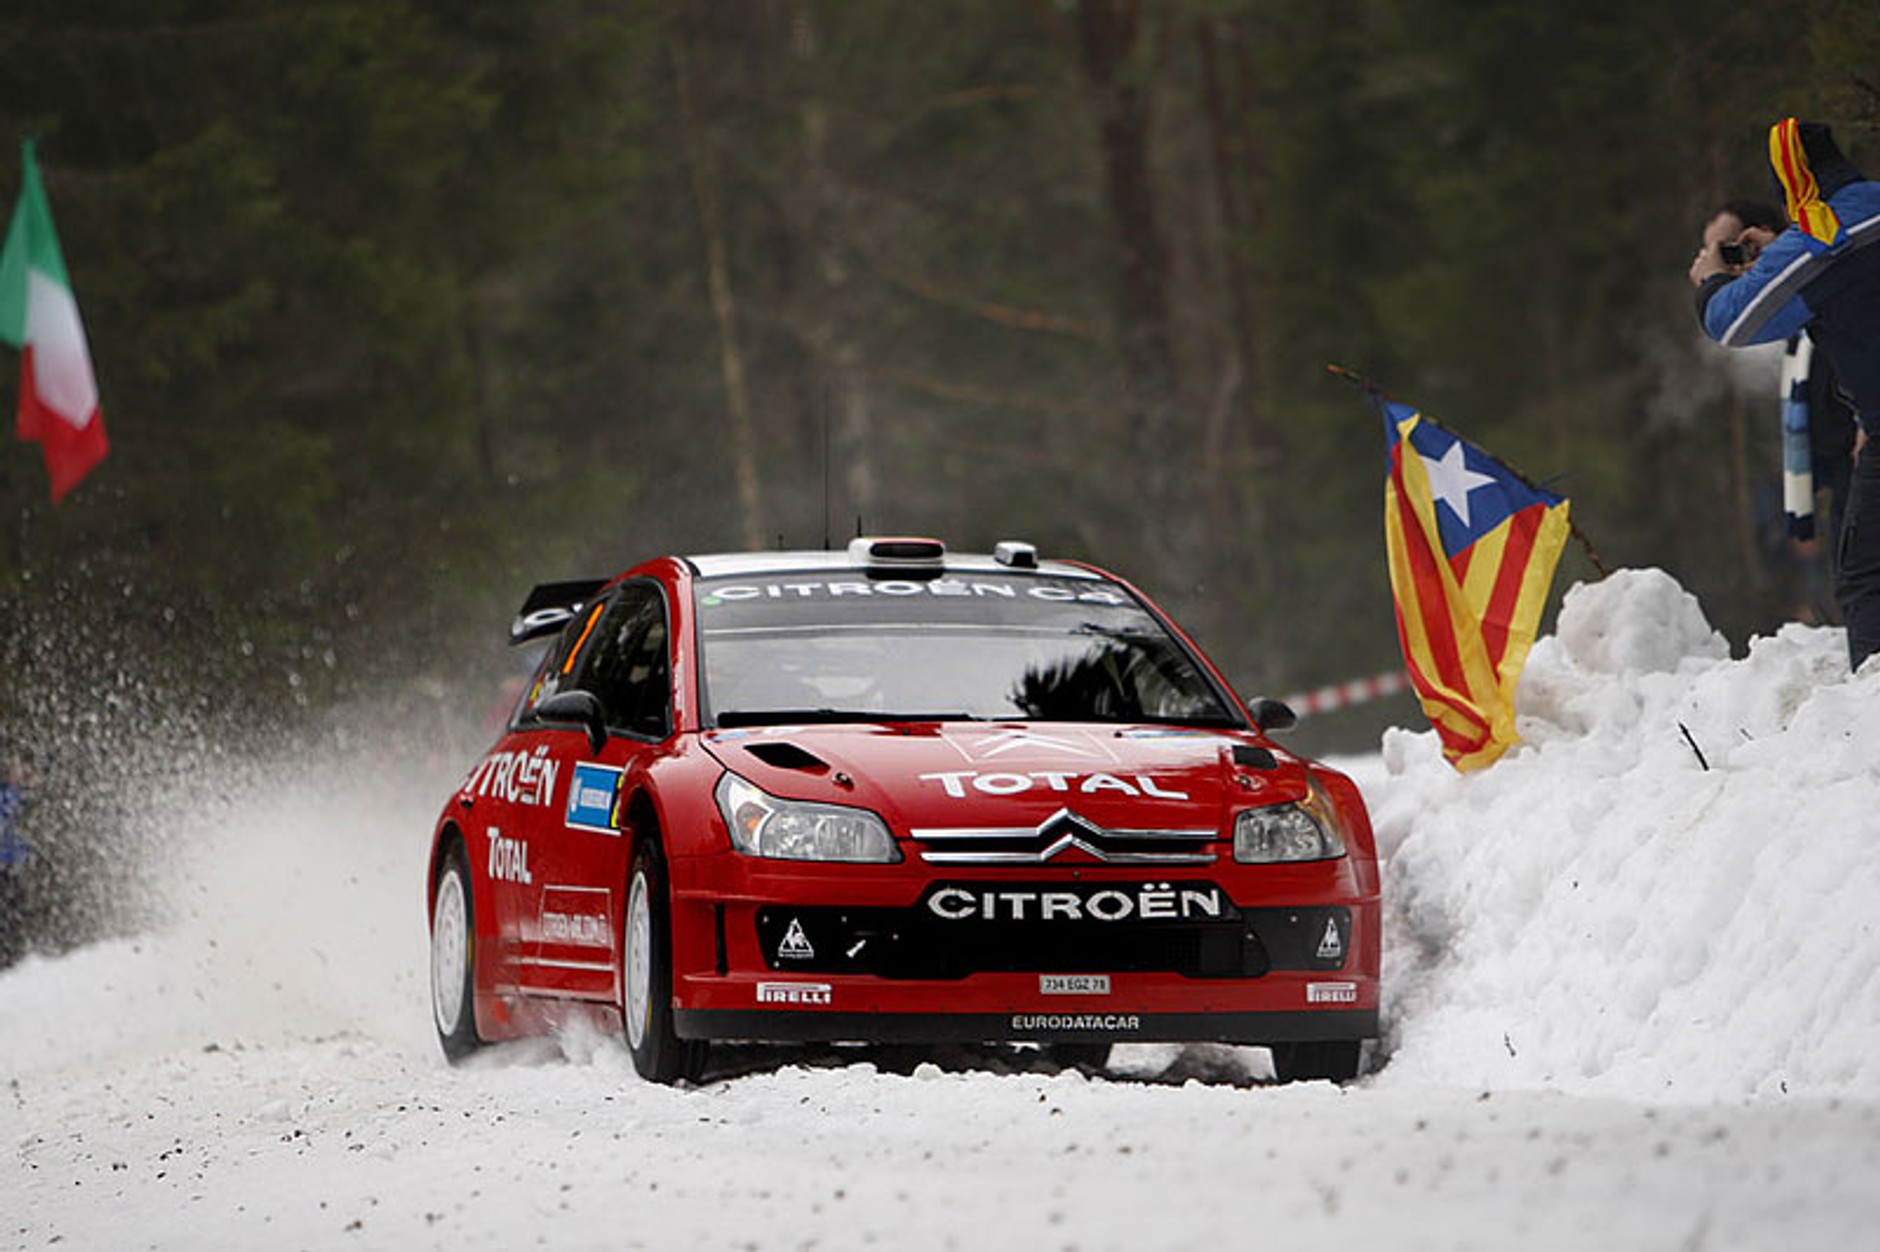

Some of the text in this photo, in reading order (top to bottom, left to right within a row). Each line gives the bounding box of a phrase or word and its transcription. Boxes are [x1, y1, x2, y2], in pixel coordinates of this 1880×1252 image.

[711, 578, 1014, 601] CITROËN
[460, 745, 561, 808] ITROËN
[918, 771, 1190, 801] TOTAL
[486, 825, 532, 885] TOTAL
[927, 881, 1222, 921] CITROËN
[756, 981, 832, 1004] PIRELLI
[1306, 982, 1357, 1003] PIRELLI
[1011, 1014, 1141, 1031] EURODATACAR
